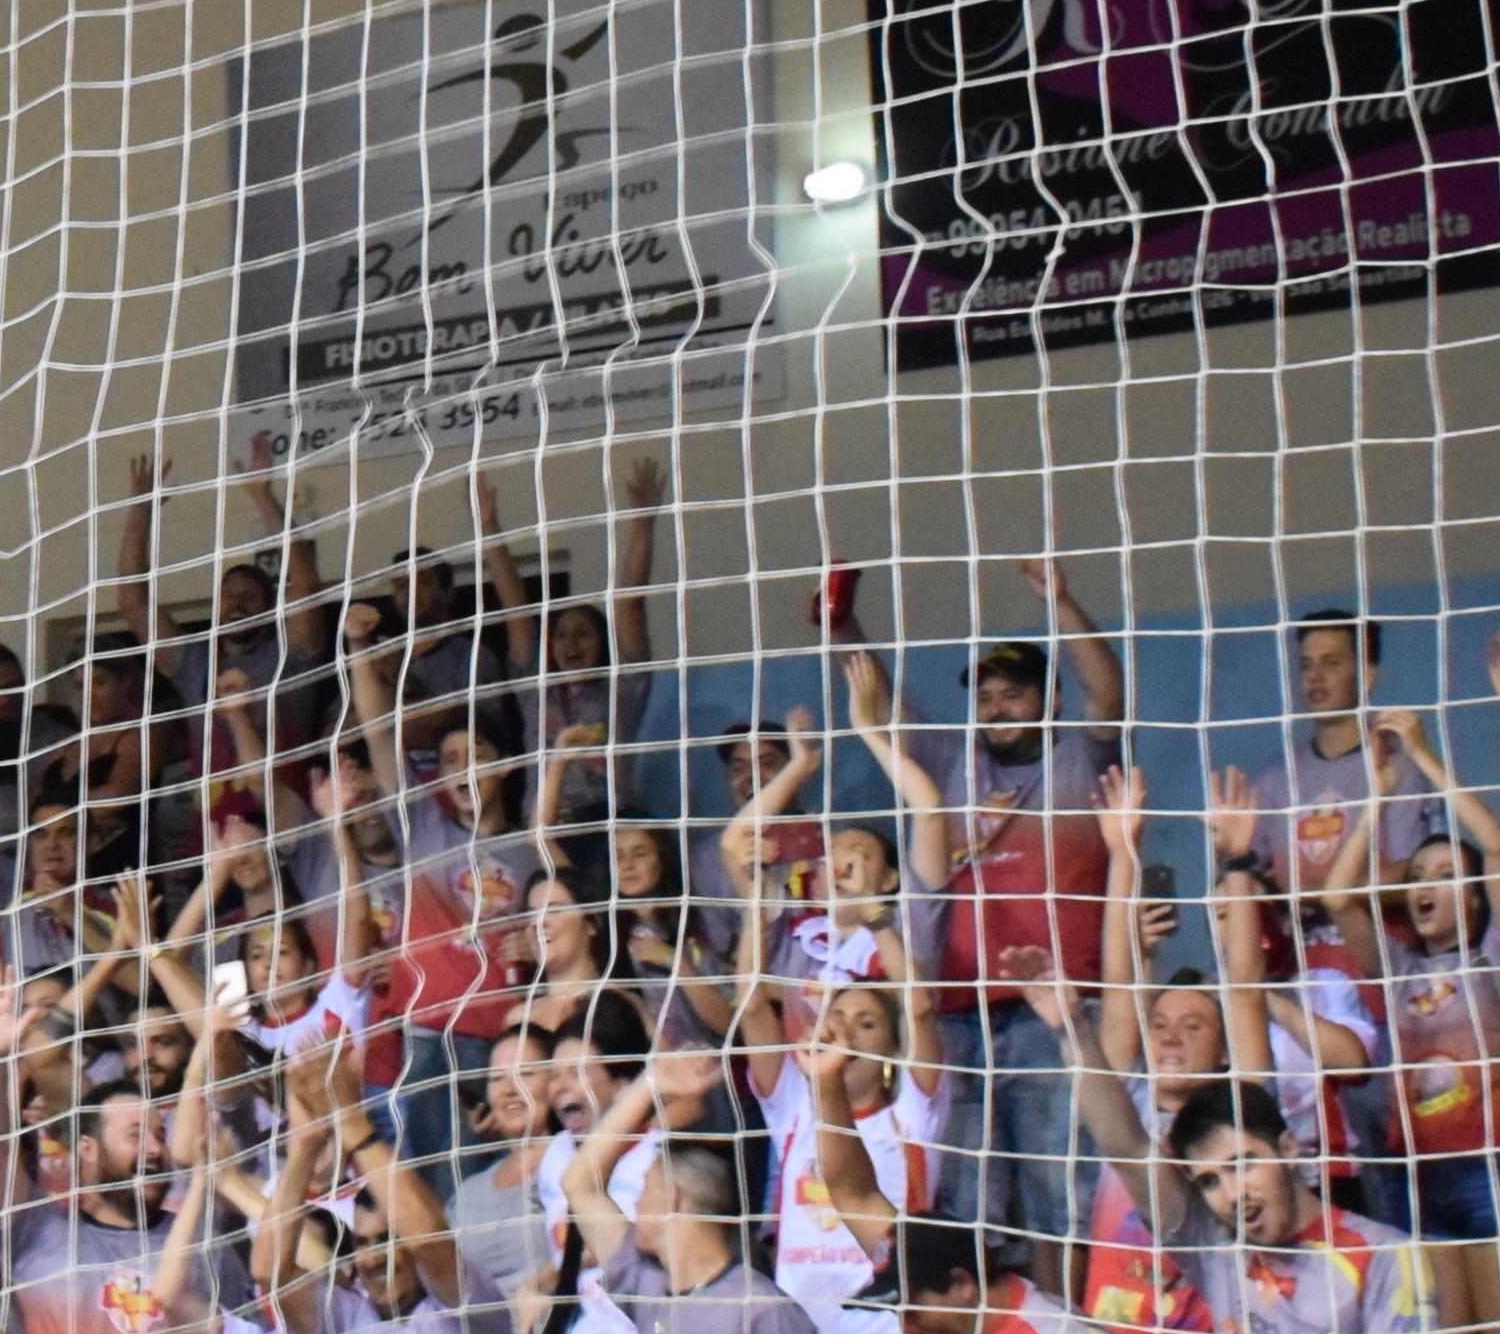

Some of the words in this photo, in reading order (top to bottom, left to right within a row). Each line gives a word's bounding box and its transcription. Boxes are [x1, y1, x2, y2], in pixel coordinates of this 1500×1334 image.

[508, 214, 668, 283] Viver
[1065, 272, 1105, 296] em
[325, 318, 518, 368] FISIOTERAPIA
